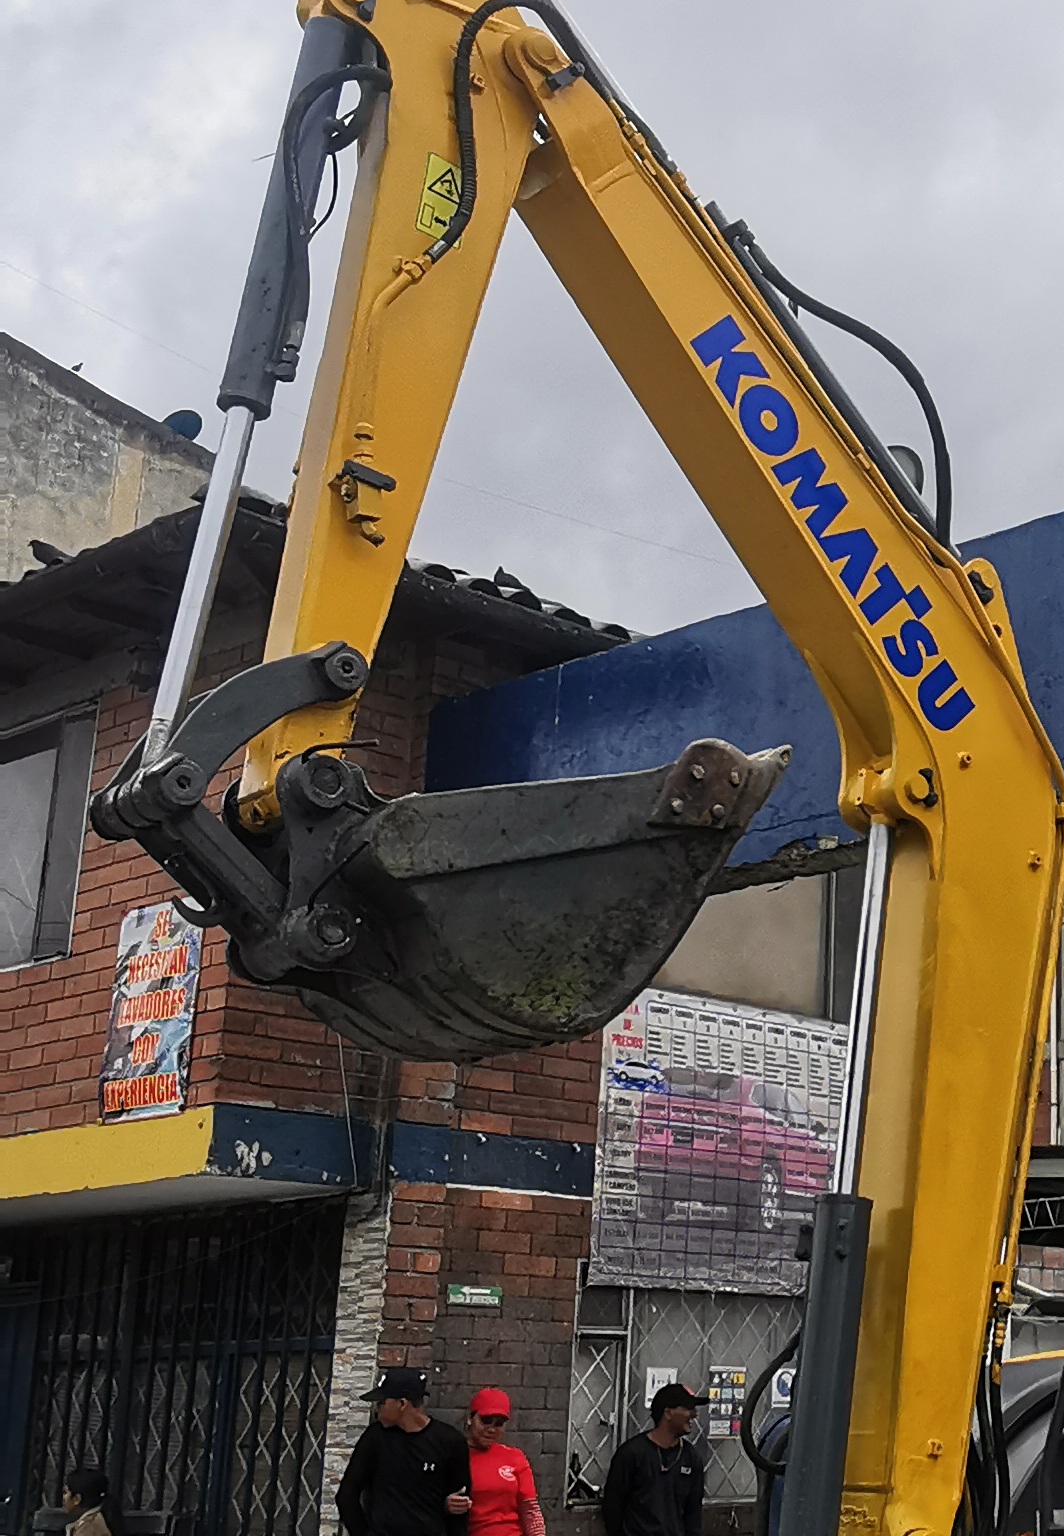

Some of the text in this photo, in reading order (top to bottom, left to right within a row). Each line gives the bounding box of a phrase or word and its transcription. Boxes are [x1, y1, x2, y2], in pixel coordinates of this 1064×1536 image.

[689, 314, 976, 731] KOMATSU
[153, 910, 171, 939] SE
[117, 987, 186, 1029] LAVADORES
[131, 1032, 160, 1067] CON
